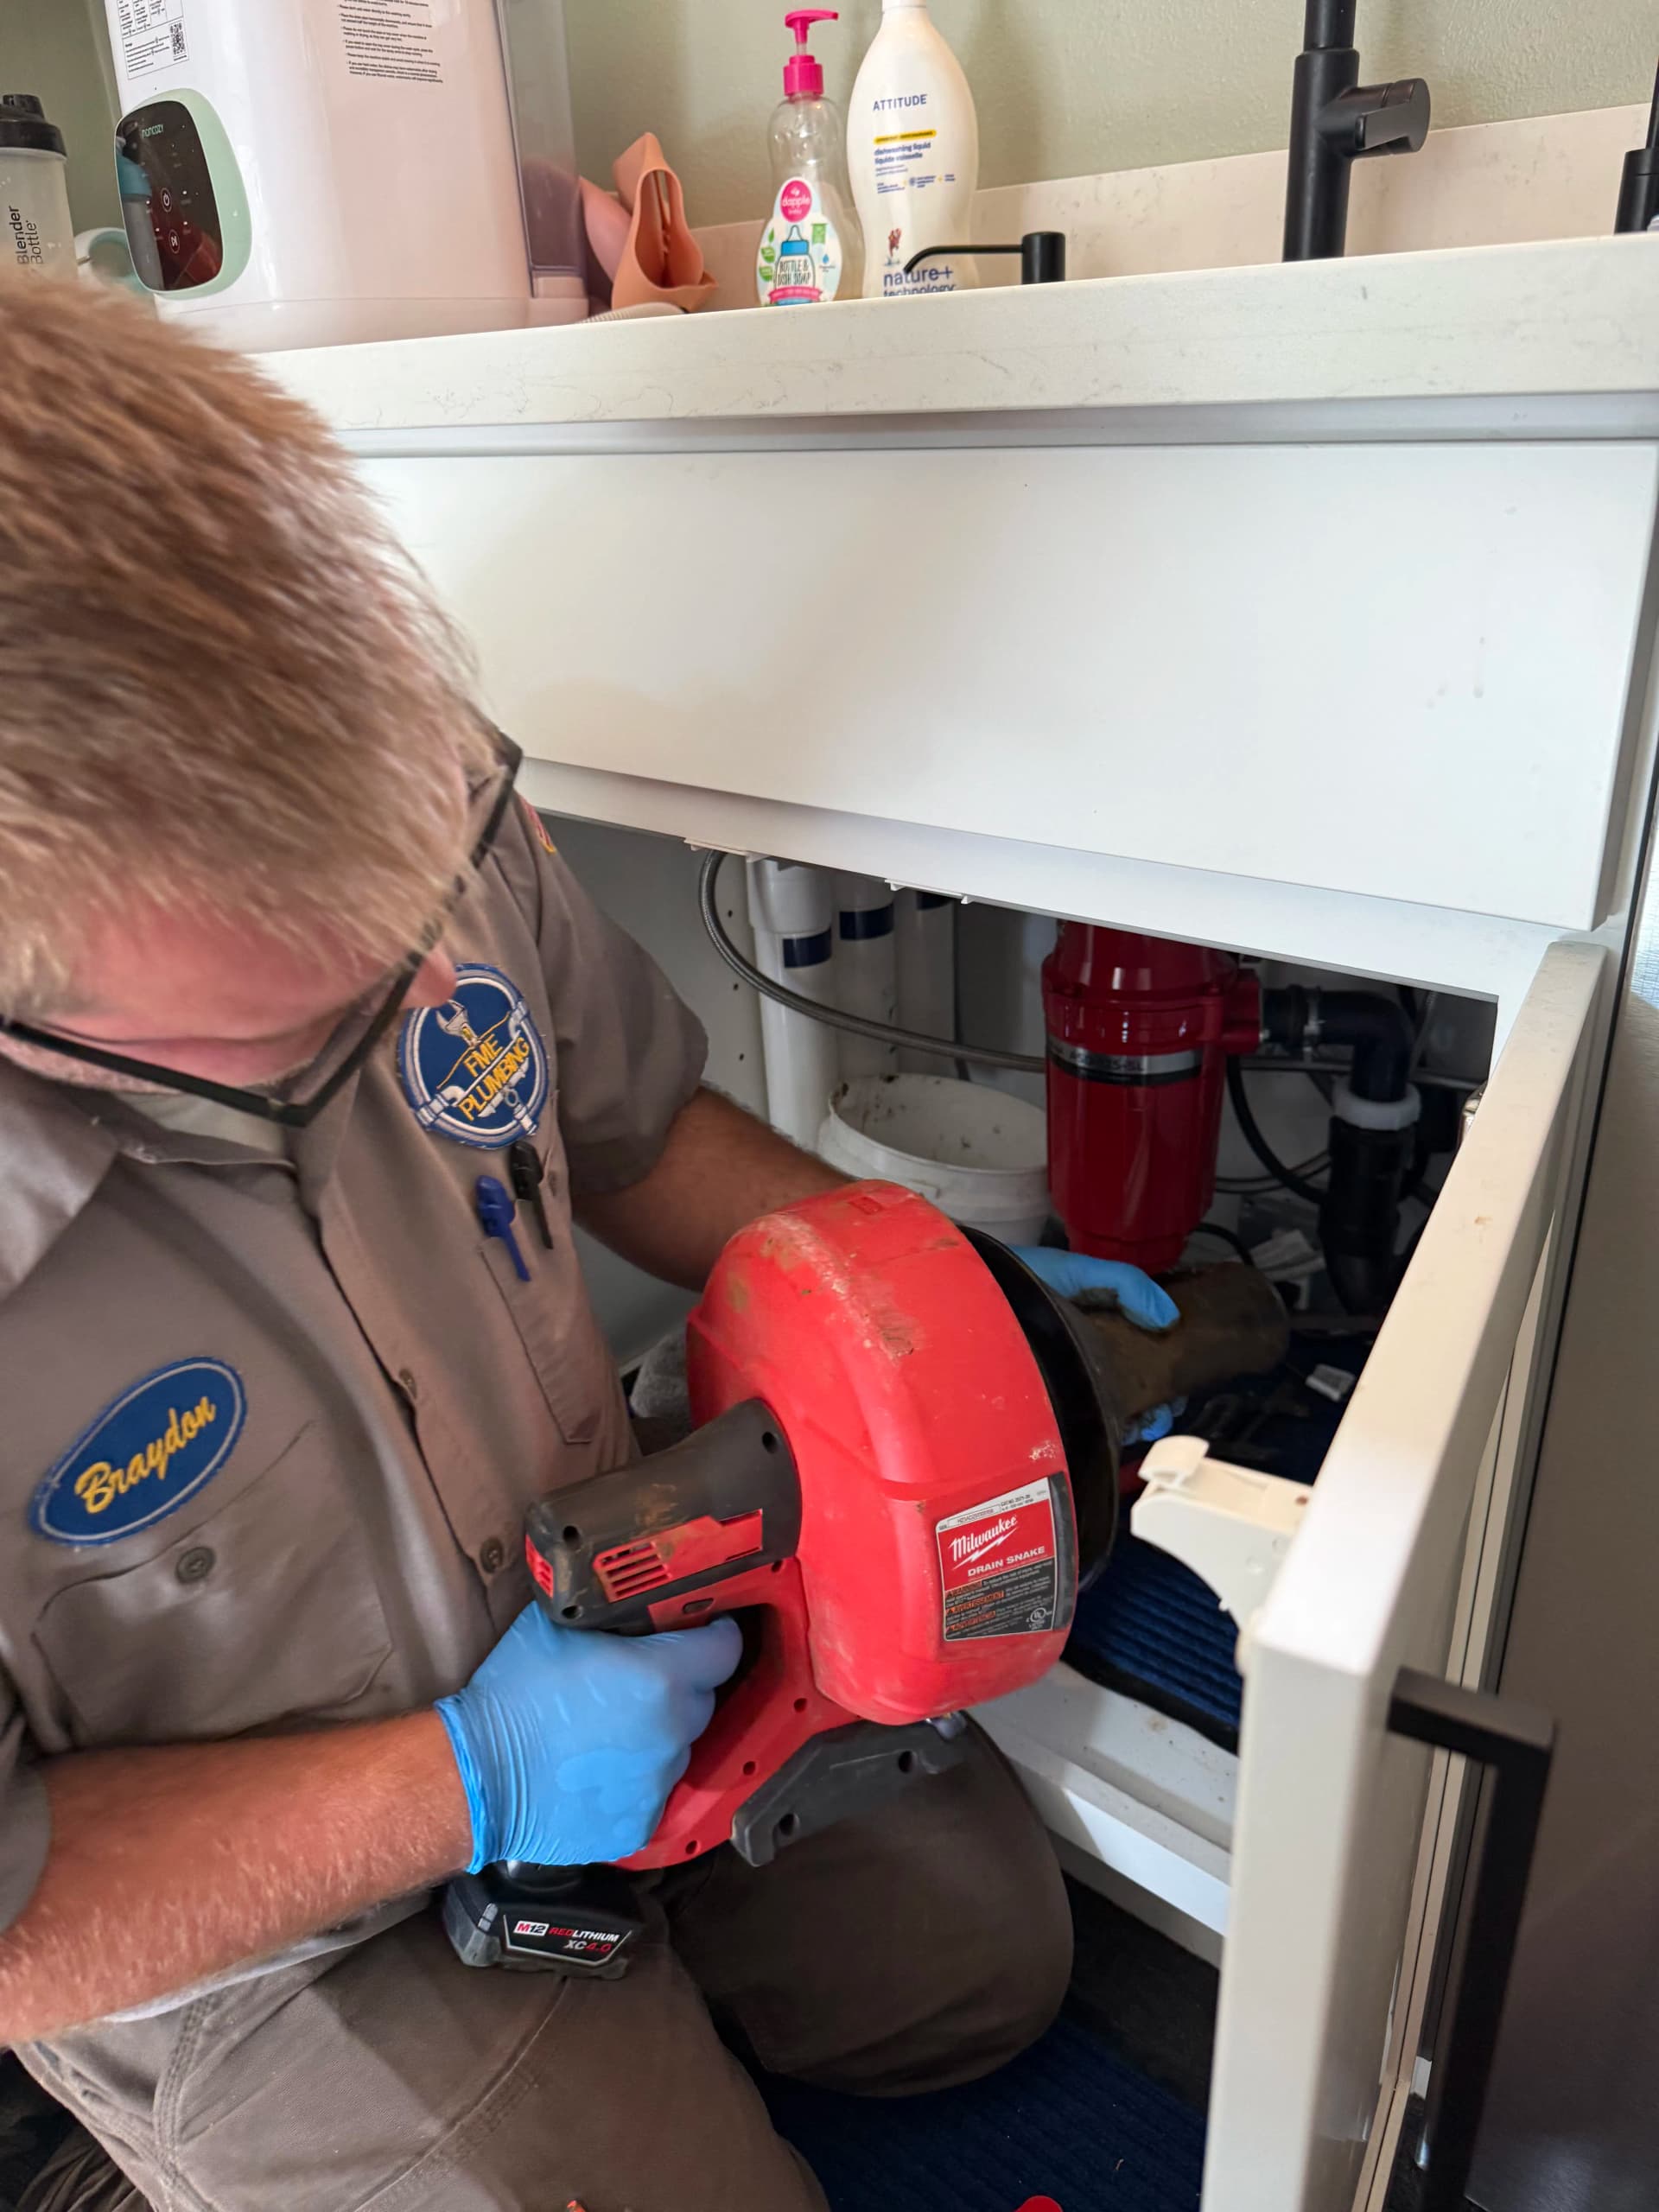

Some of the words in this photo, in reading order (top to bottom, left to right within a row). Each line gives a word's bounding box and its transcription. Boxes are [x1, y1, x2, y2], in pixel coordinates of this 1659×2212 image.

[873, 94, 927, 111] ATTITUDE
[9, 206, 29, 264] Blender
[25, 222, 43, 264] Bottle
[464, 1033, 503, 1077] FME
[458, 1037, 530, 1122] PLUMBING
[948, 1516, 1017, 1561] Milwaukee
[968, 1560, 1003, 1577] DRAIN
[1007, 1546, 1045, 1564] SNAKE
[517, 1923, 546, 1934] M12
[548, 1927, 620, 1942] REDLITHIUM
[563, 1940, 613, 1953] XC4.0
